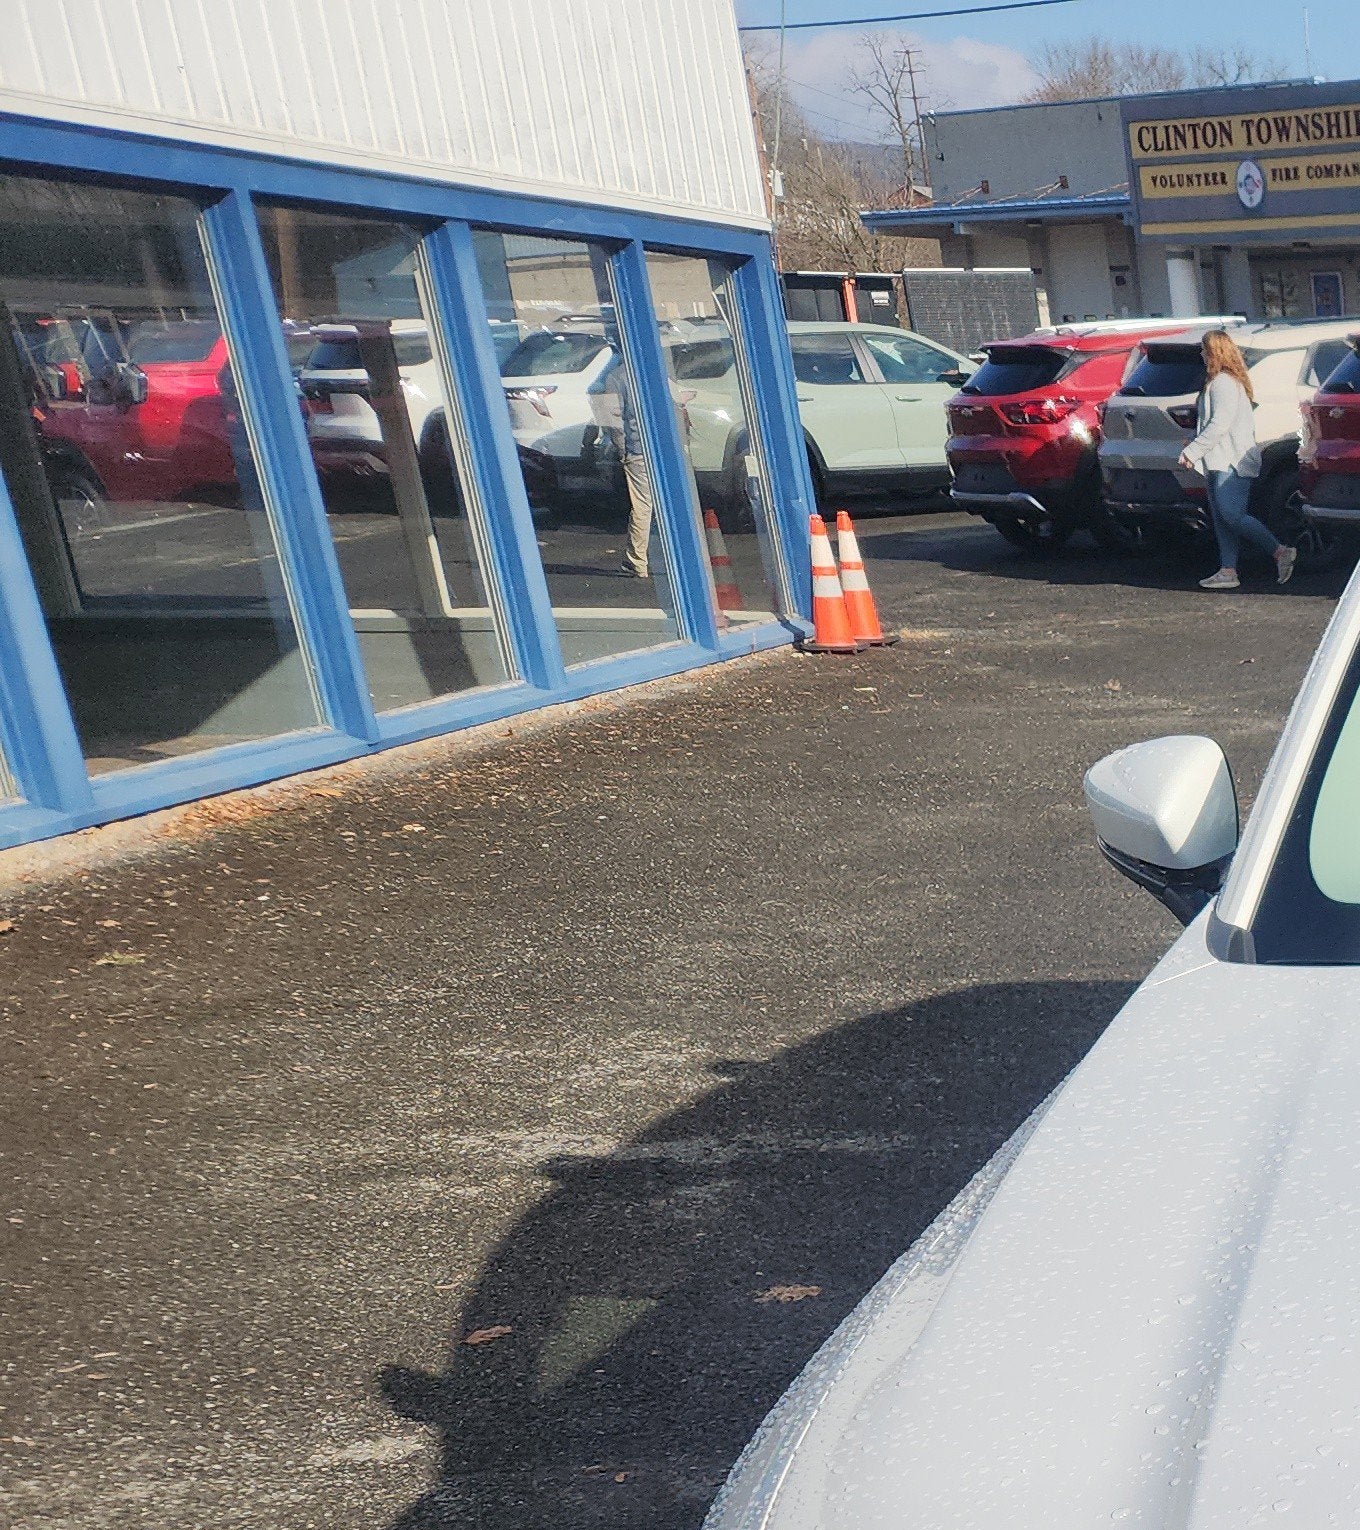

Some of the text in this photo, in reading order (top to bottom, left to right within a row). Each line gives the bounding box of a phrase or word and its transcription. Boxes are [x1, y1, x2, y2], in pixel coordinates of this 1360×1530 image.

[1137, 119, 1233, 152] CLINTON
[1150, 171, 1228, 188] VOLUNTEER
[1271, 166, 1300, 182] FIRE
